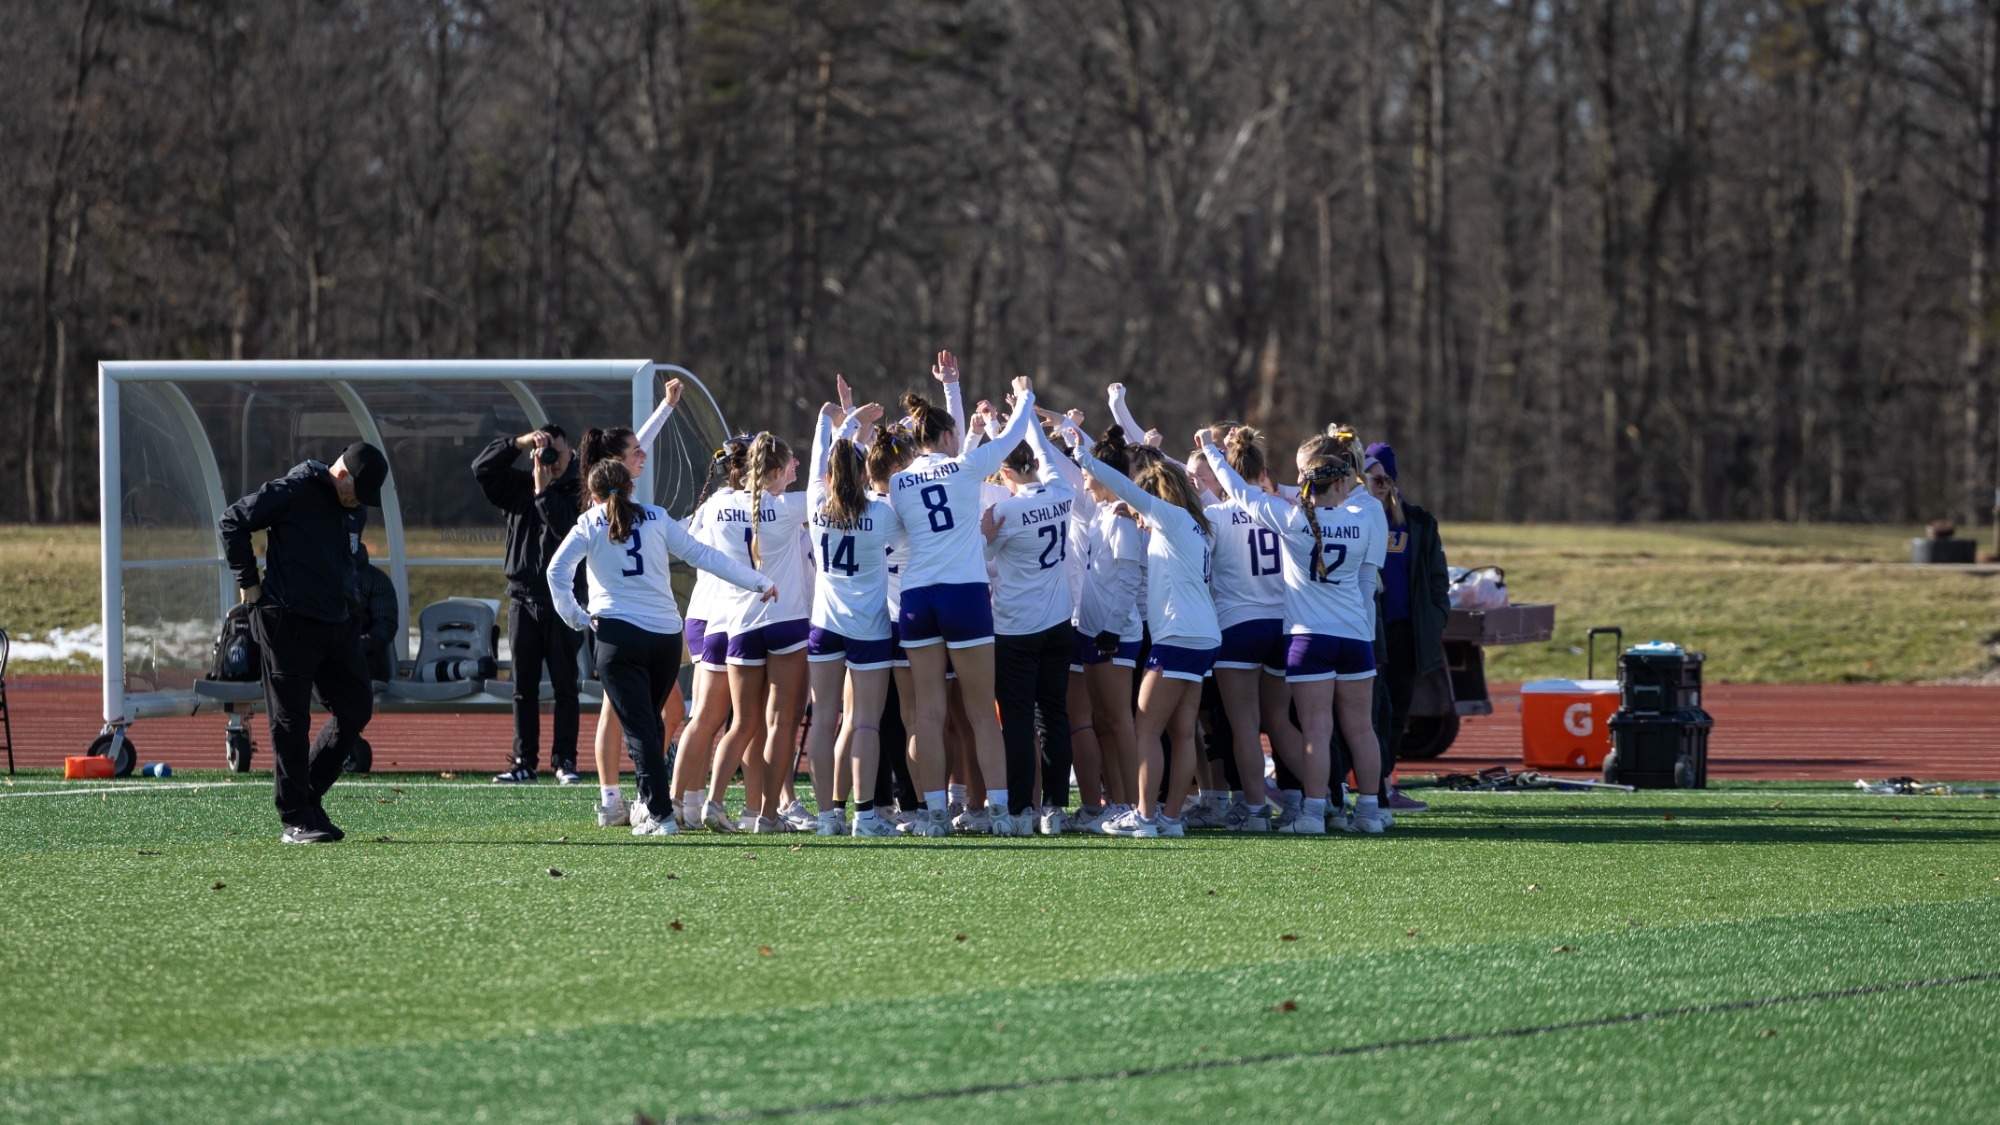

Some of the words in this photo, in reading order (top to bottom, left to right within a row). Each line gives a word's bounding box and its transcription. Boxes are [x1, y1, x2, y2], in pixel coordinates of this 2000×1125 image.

[898, 462, 960, 491] ASHLAND
[717, 508, 777, 523] ASHLND
[920, 484, 955, 533] 8
[1021, 499, 1072, 526] ASHLAND
[621, 527, 645, 578] 3
[820, 532, 860, 577] 14
[1037, 520, 1067, 570] 21
[1247, 526, 1281, 577] 19
[1309, 542, 1347, 586] 12
[1563, 702, 1594, 738] G
